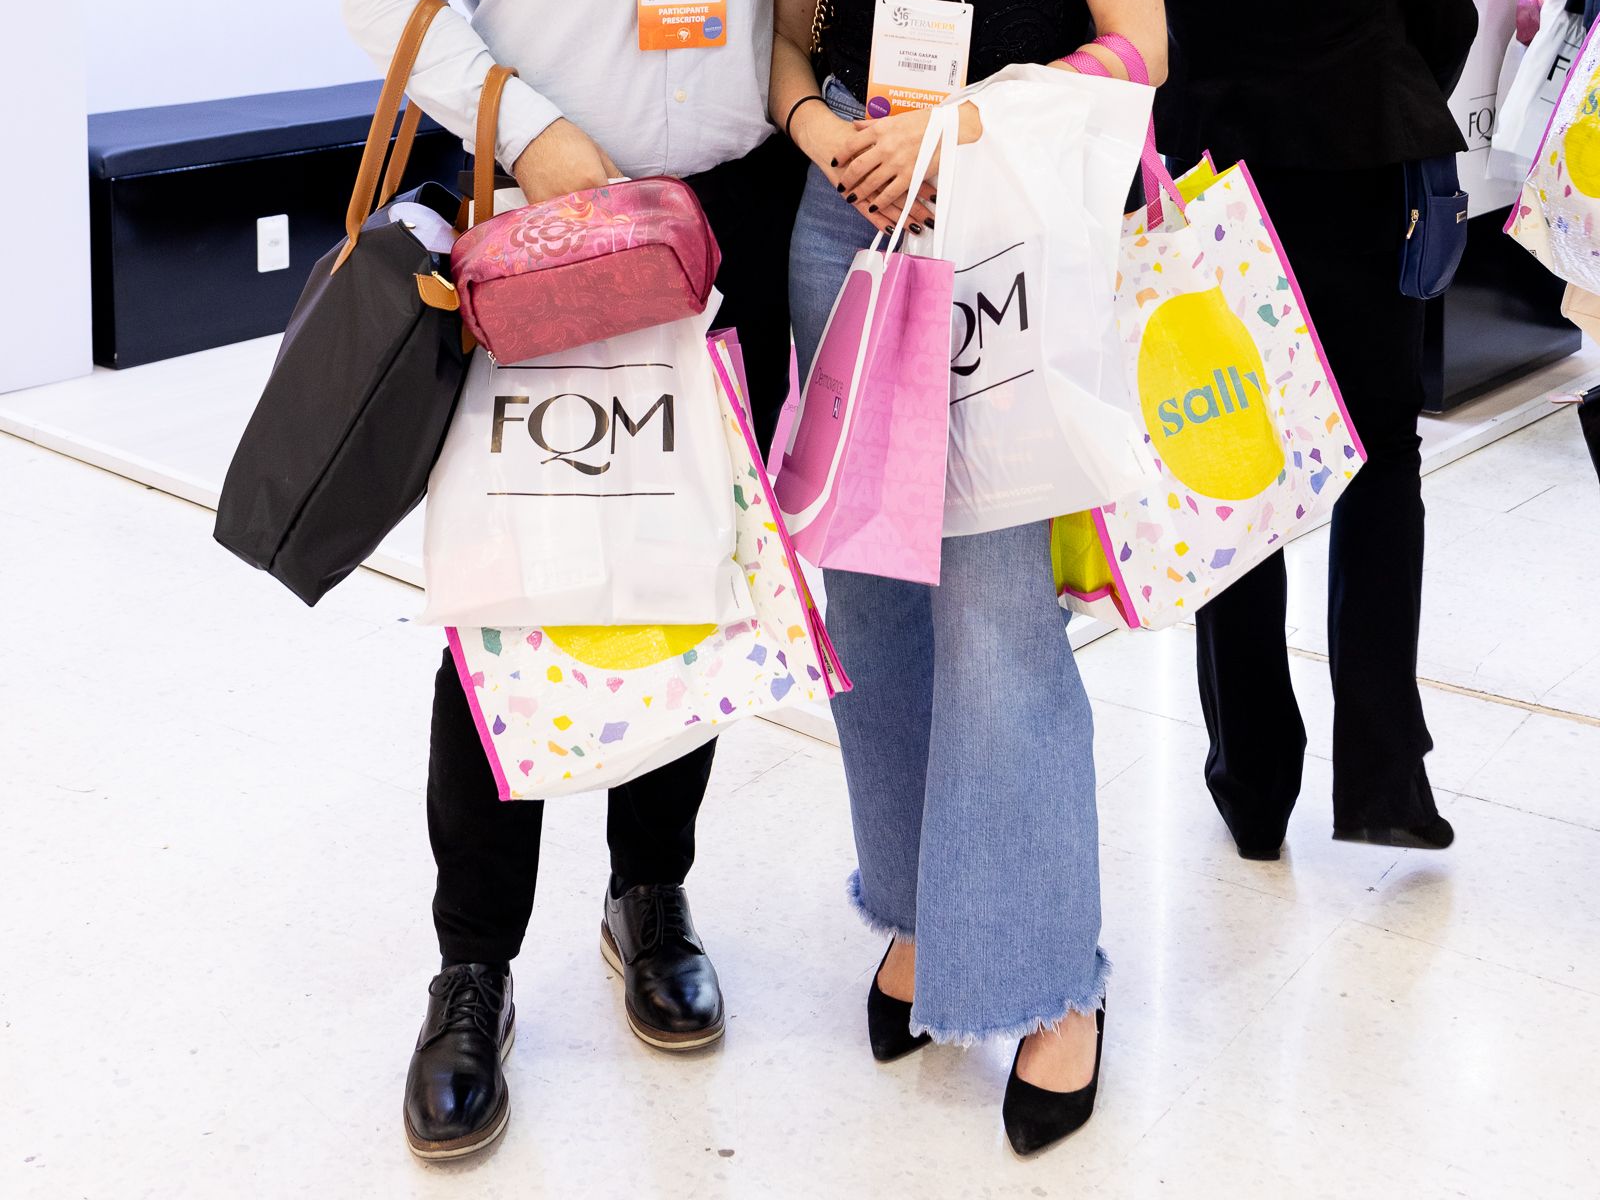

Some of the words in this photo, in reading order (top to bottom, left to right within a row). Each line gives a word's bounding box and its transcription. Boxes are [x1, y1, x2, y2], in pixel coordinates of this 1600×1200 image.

[658, 6, 709, 15] PARTICIPANTE
[662, 15, 706, 24] PRESCRITOR
[888, 89, 944, 102] PARTICIPANTE
[891, 99, 934, 109] PRESCRITO
[1468, 107, 1496, 141] FQ
[490, 394, 675, 475] FQM
